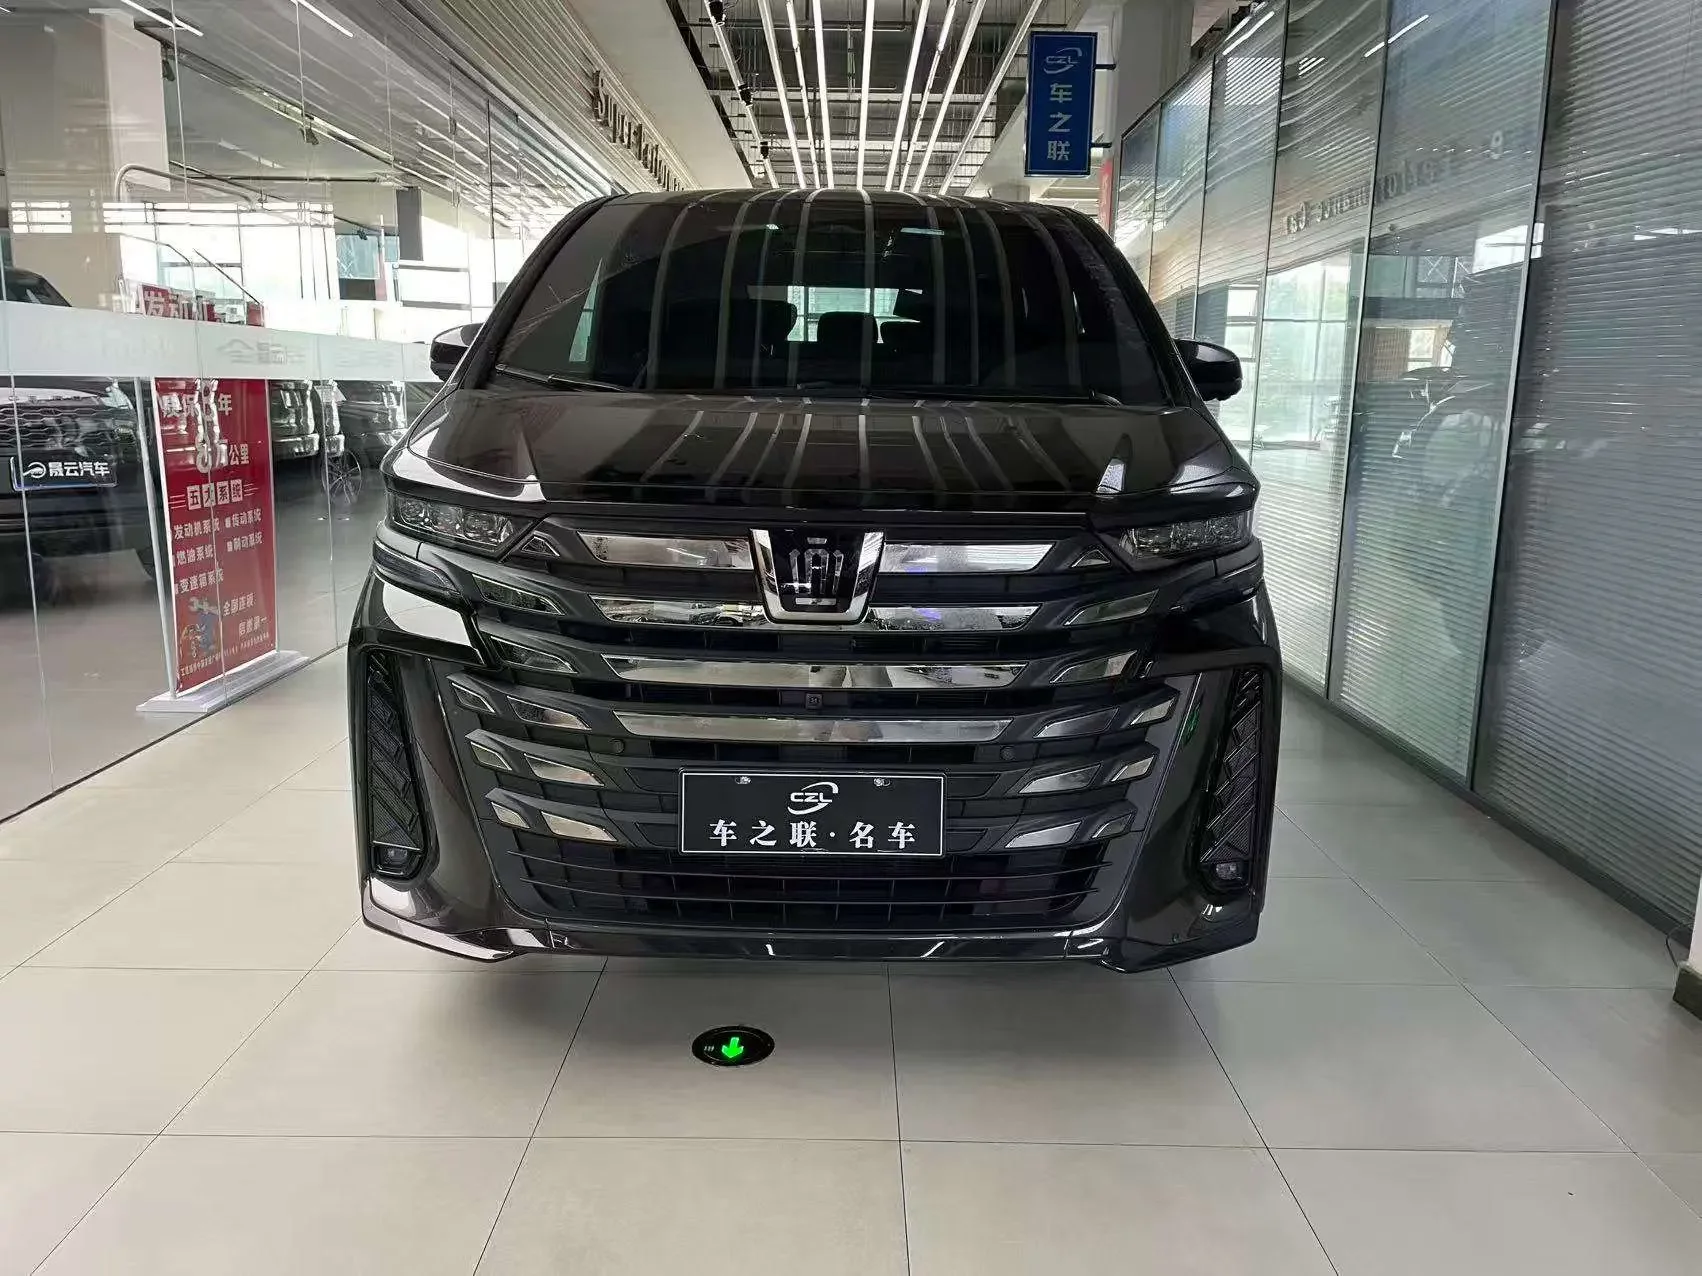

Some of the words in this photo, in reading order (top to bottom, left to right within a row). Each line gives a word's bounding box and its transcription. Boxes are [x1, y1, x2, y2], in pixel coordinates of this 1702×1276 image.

[1047, 82, 1073, 161] 车之联
[790, 792, 833, 804] CZL
